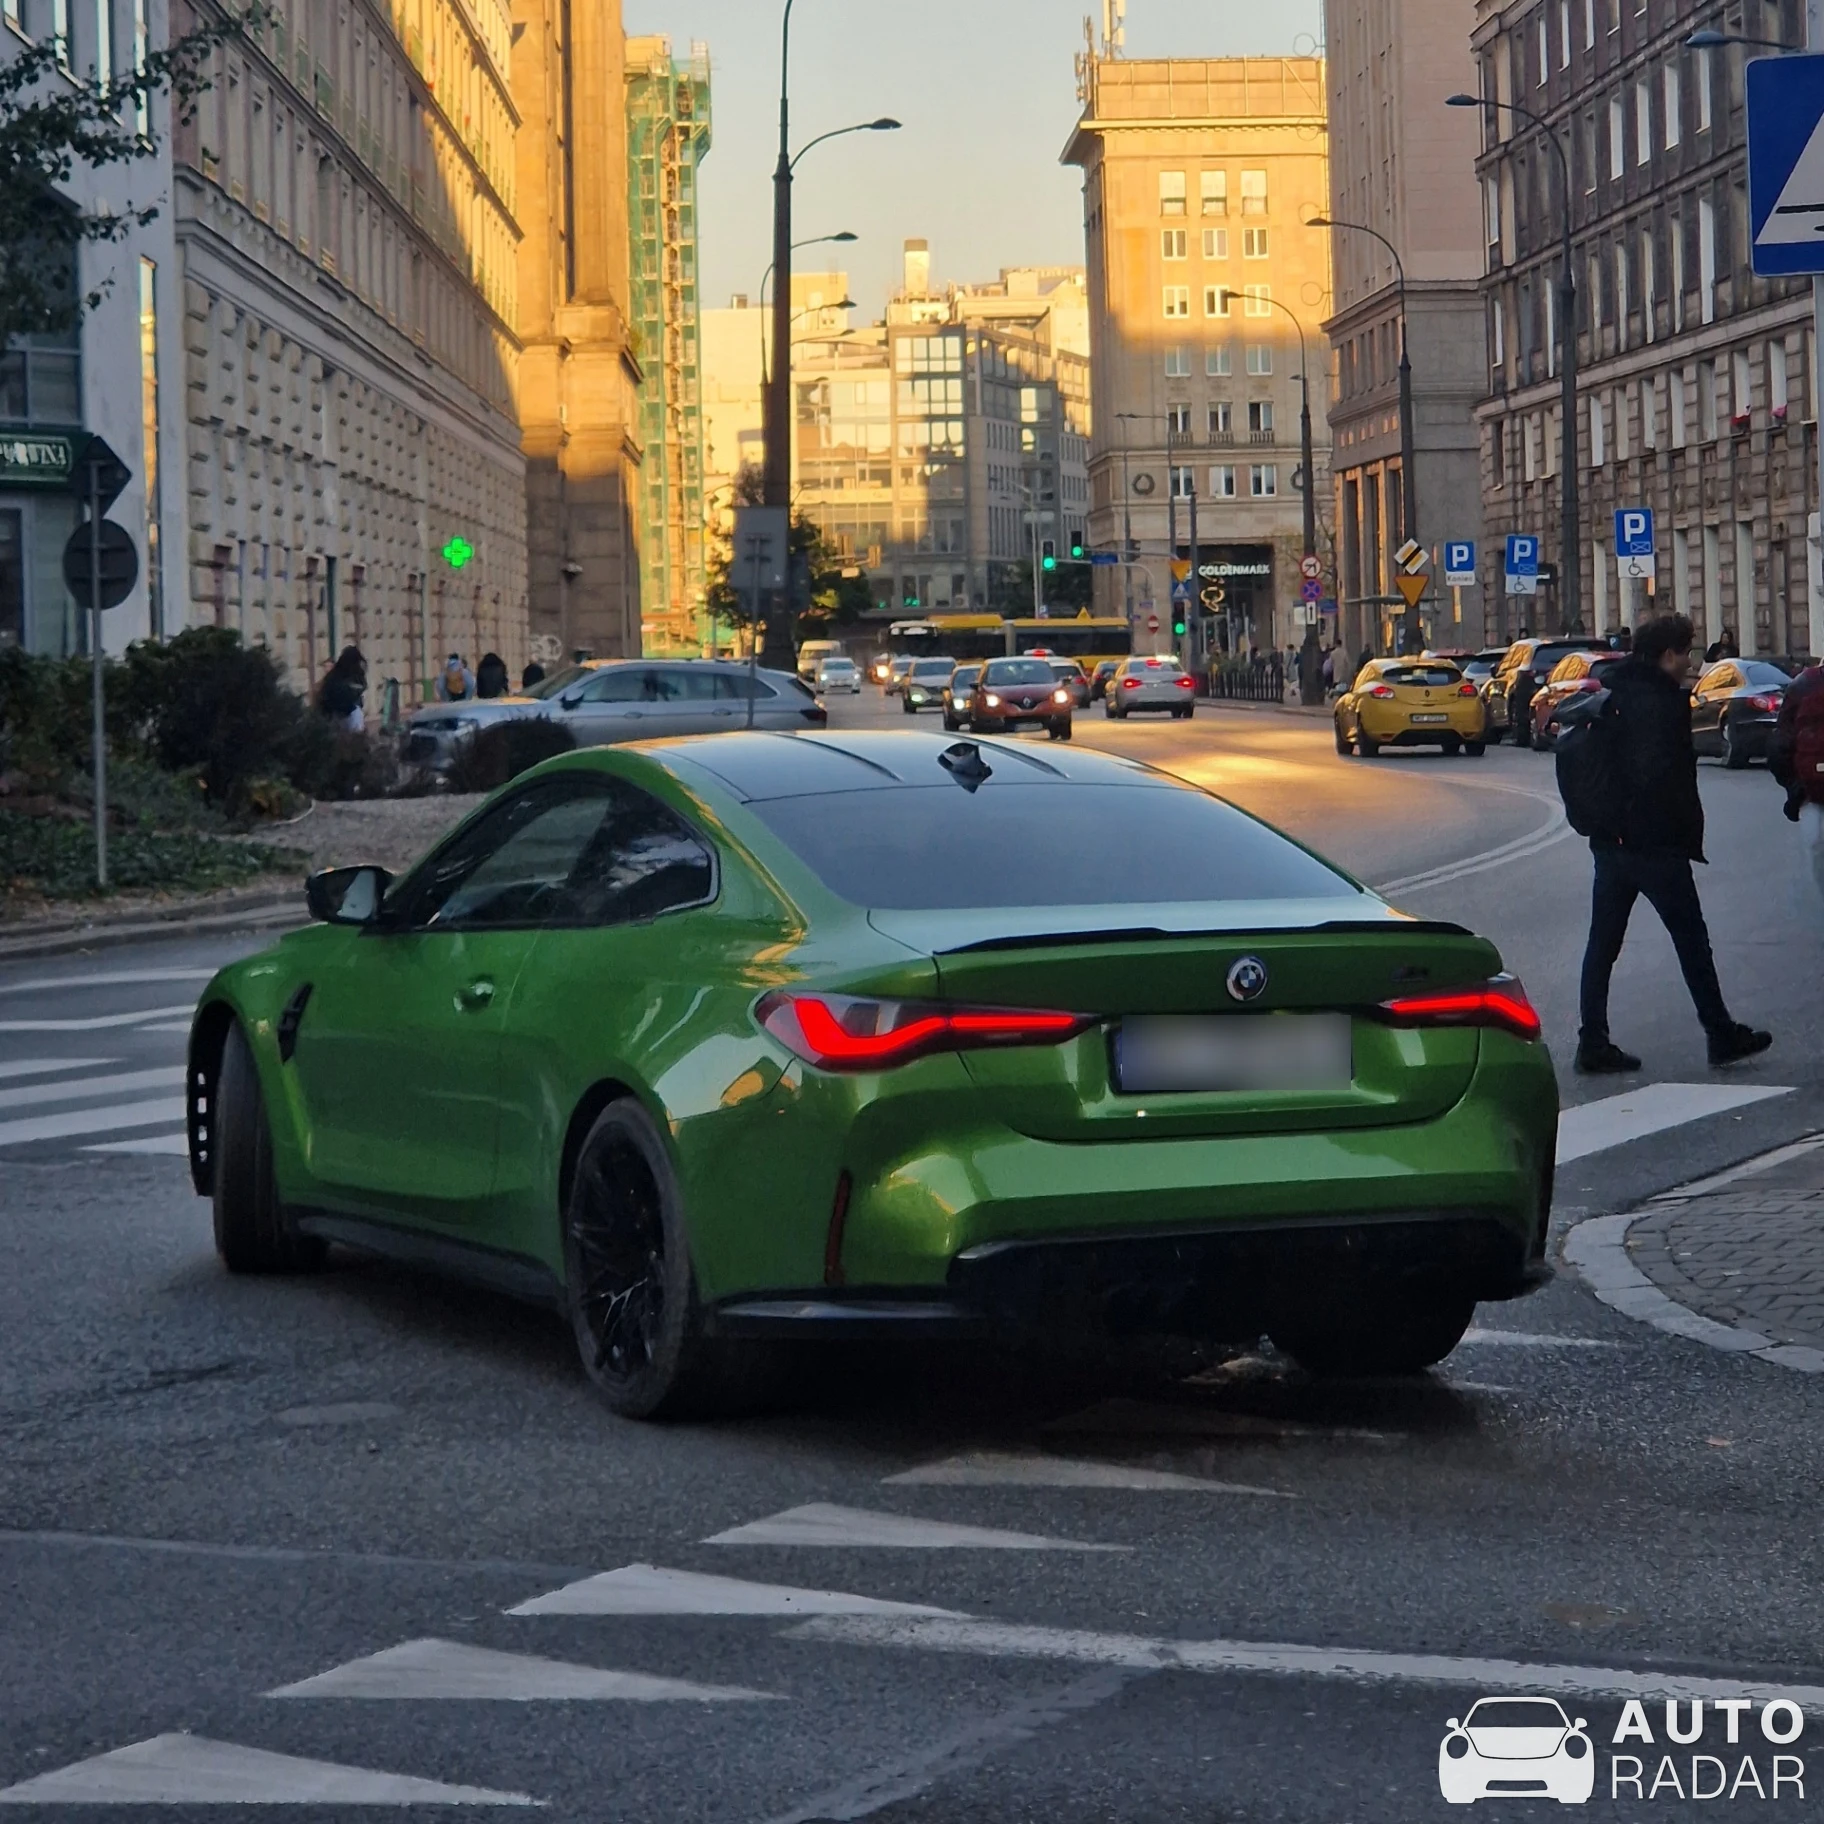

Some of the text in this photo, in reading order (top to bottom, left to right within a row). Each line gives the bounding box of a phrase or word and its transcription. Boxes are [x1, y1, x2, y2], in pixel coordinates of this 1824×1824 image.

[1624, 513, 1645, 542] P
[1452, 545, 1469, 568] P
[1513, 539, 1532, 563] P
[1198, 564, 1270, 576] GOLDENMARK
